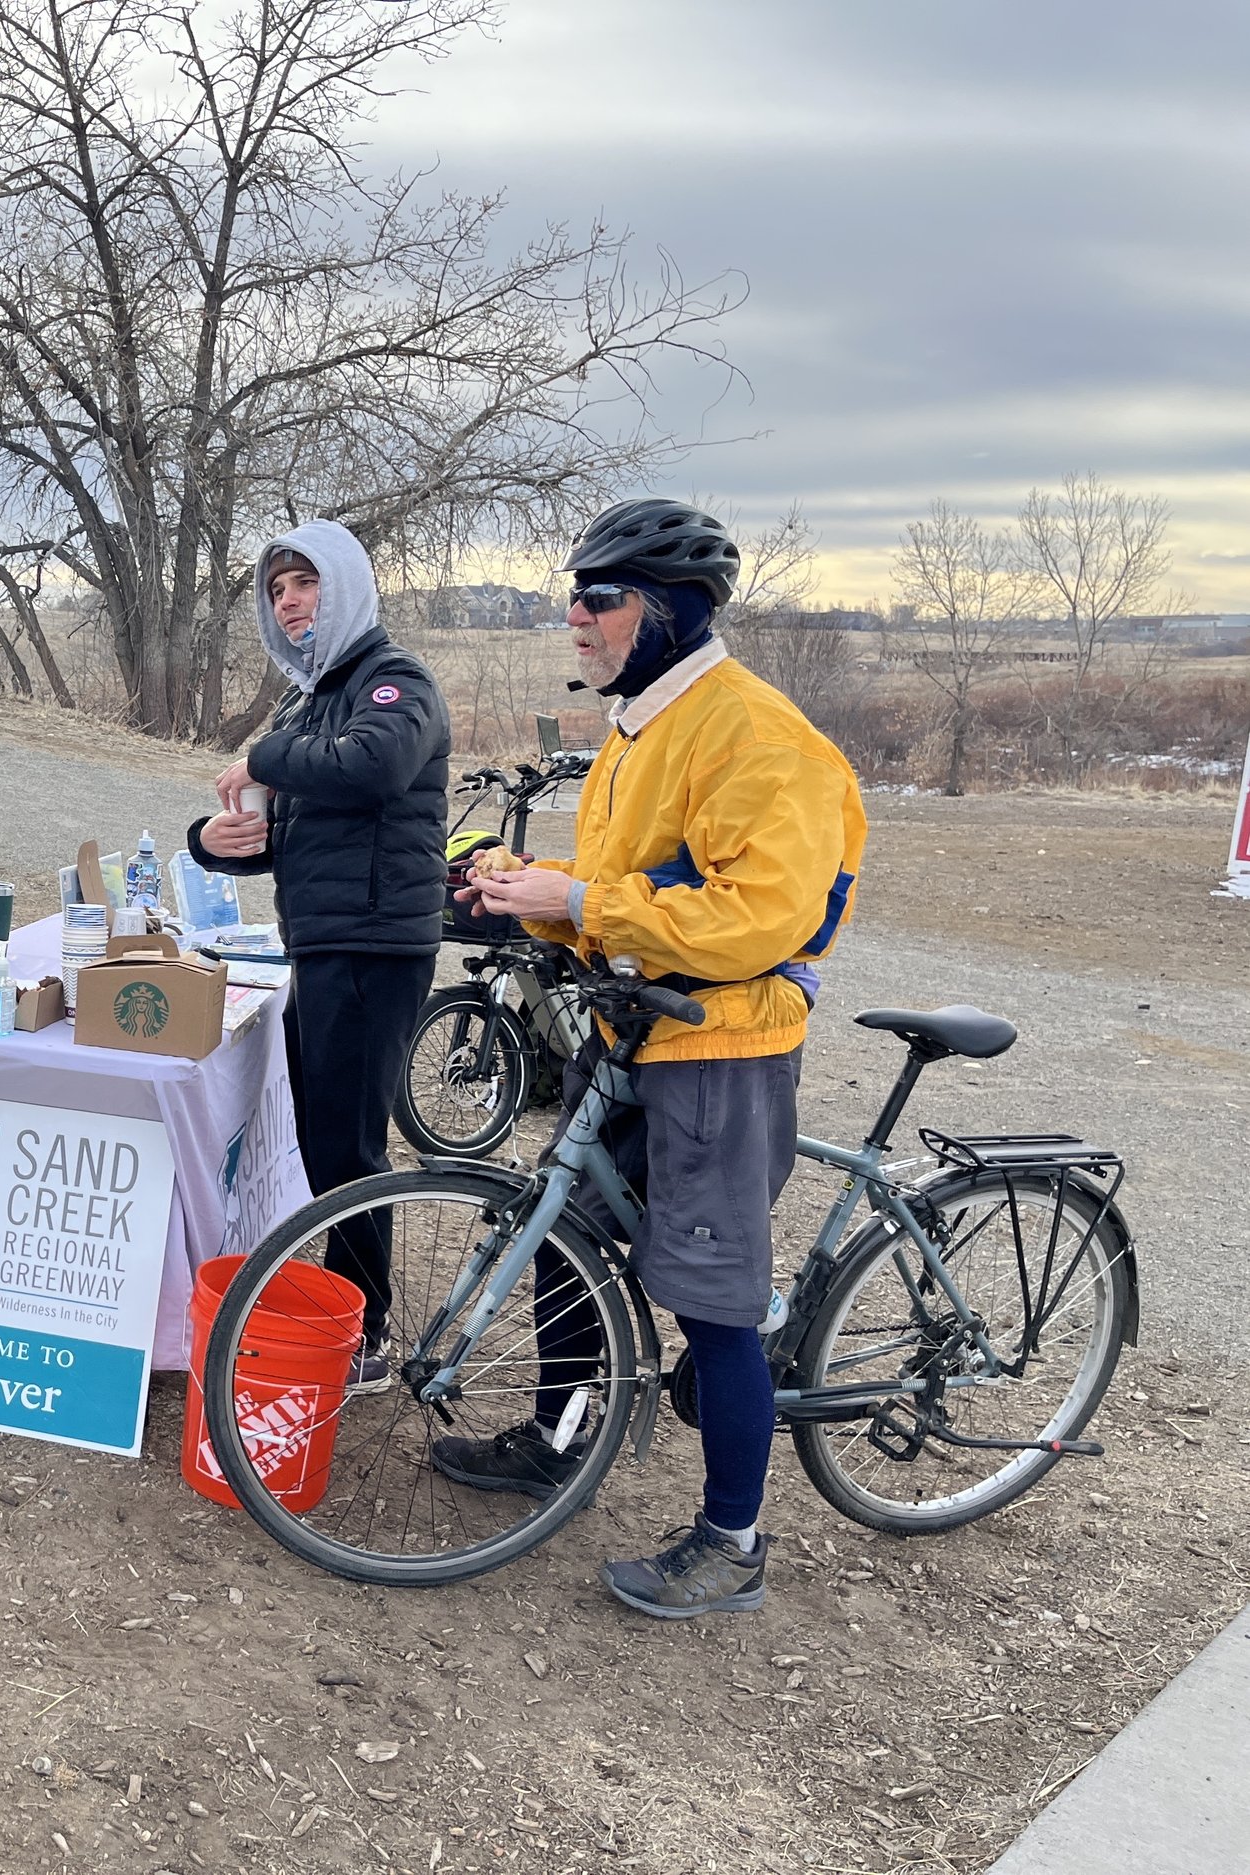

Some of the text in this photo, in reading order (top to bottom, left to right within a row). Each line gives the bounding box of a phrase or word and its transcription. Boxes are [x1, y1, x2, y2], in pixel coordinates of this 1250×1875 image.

[12, 1129, 140, 1194] SAND
[7, 1183, 134, 1243] CREEK
[3, 1230, 126, 1273] REGIONAL
[0, 1259, 125, 1302] GREENWAY
[60, 1306, 71, 1321] In
[74, 1309, 93, 1324] the
[95, 1312, 119, 1331] City
[40, 1345, 74, 1368] TO
[235, 1390, 260, 1419] HE
[251, 1426, 309, 1480] EPOT
